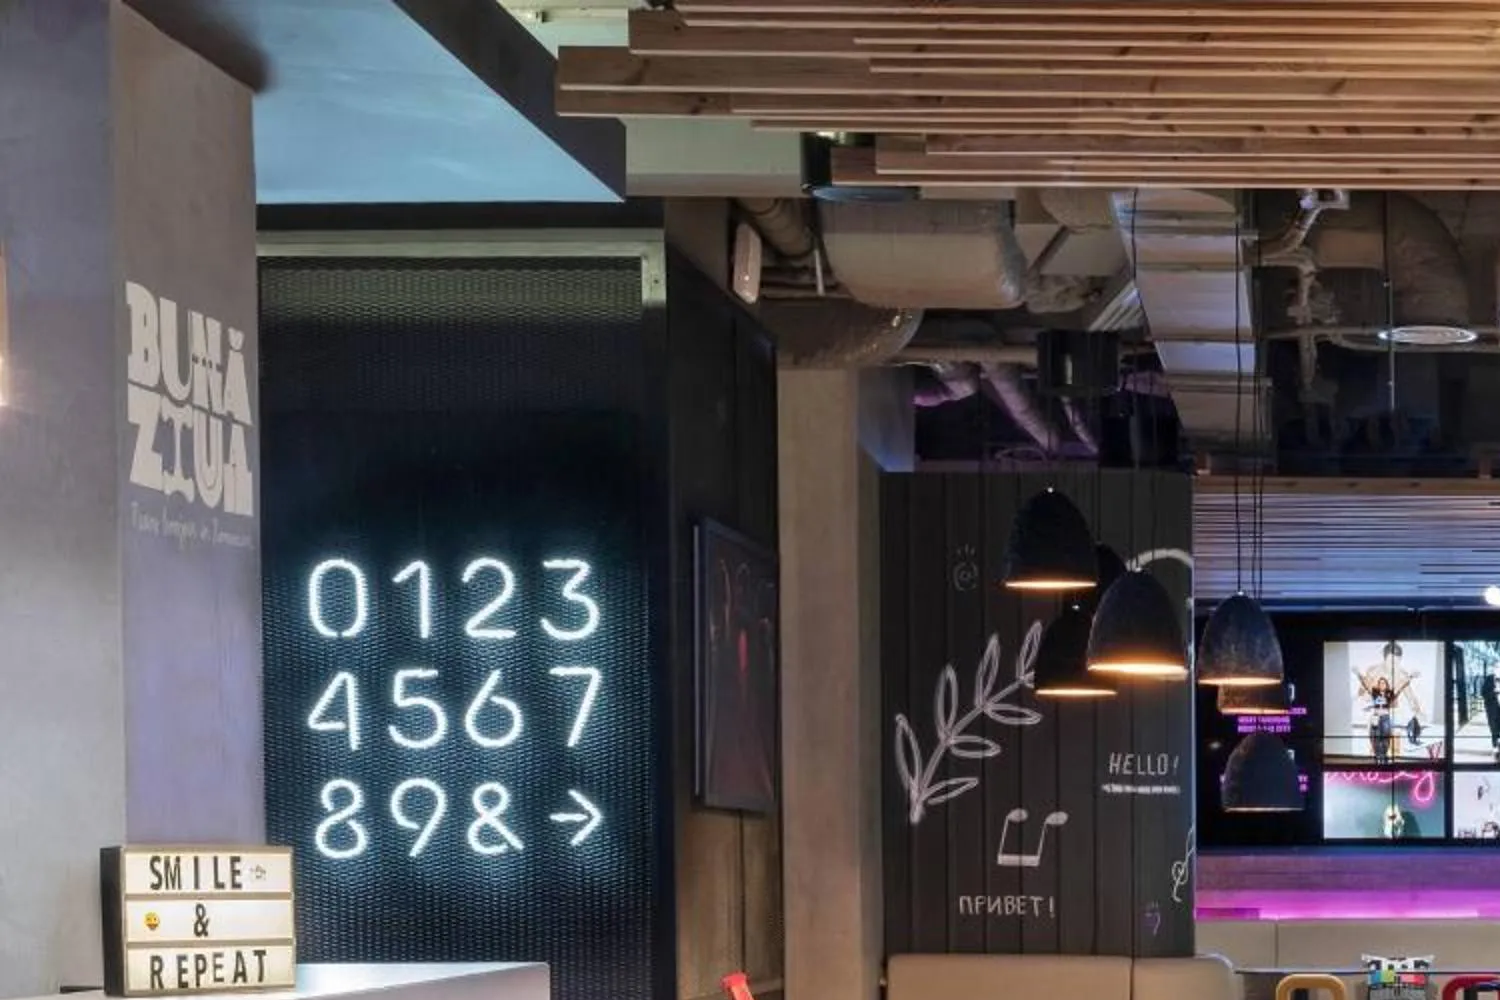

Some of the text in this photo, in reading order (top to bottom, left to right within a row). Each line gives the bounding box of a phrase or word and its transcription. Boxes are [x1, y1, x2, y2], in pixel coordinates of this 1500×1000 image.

[128, 383, 254, 516] ZIUA
[1108, 752, 1180, 776] HELLO!
[150, 855, 243, 891] SMILE
[193, 903, 210, 937] &
[959, 895, 1056, 919] ПРИВЕТ!
[150, 949, 268, 990] REPEAT
